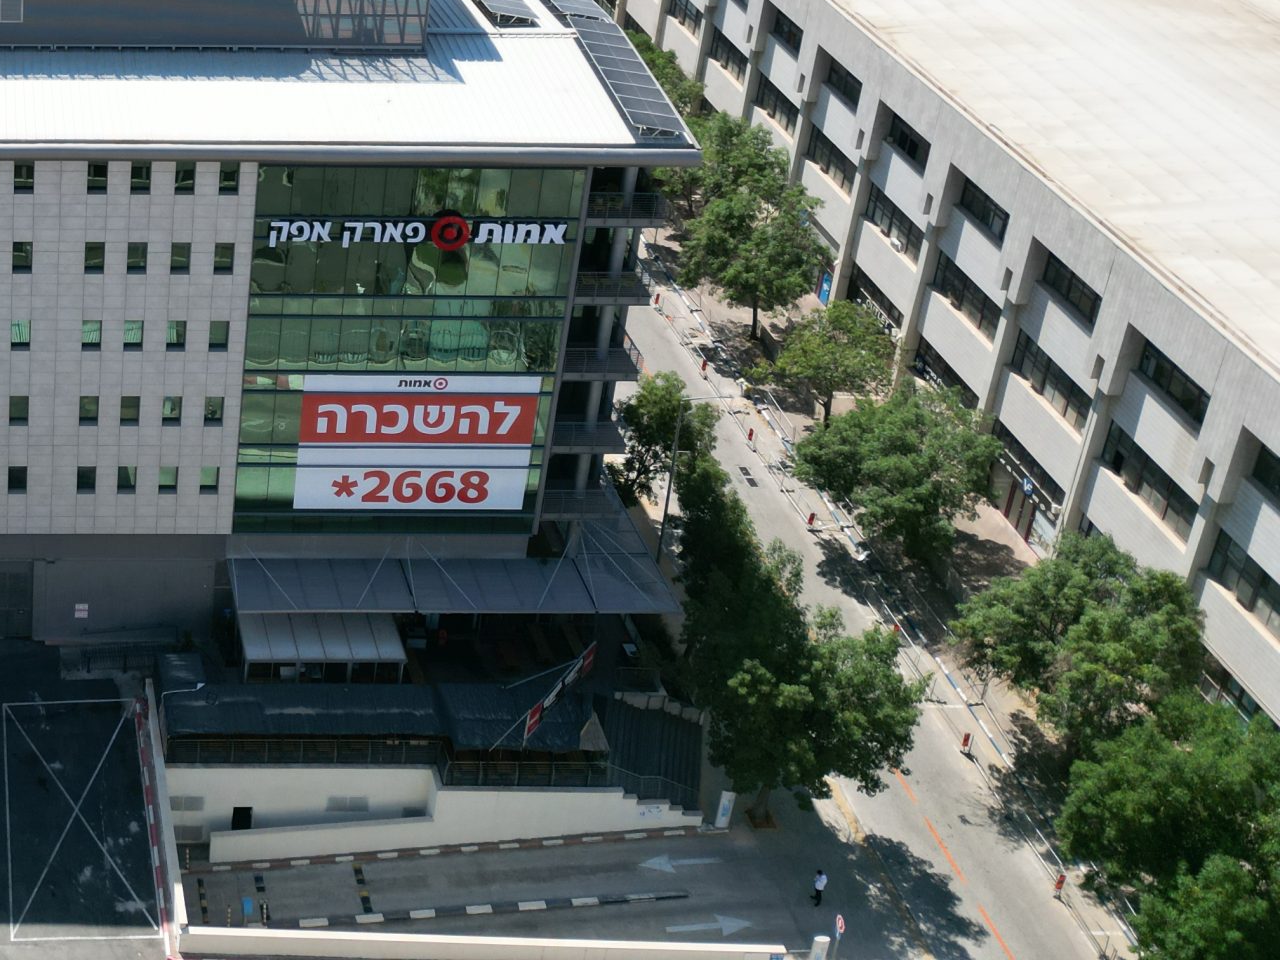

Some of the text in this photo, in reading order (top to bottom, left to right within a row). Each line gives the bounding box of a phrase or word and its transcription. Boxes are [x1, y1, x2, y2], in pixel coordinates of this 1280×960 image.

[269, 221, 568, 248] אמות פארק אפק
[397, 378, 432, 389] אמות
[316, 400, 521, 435] להשכרה
